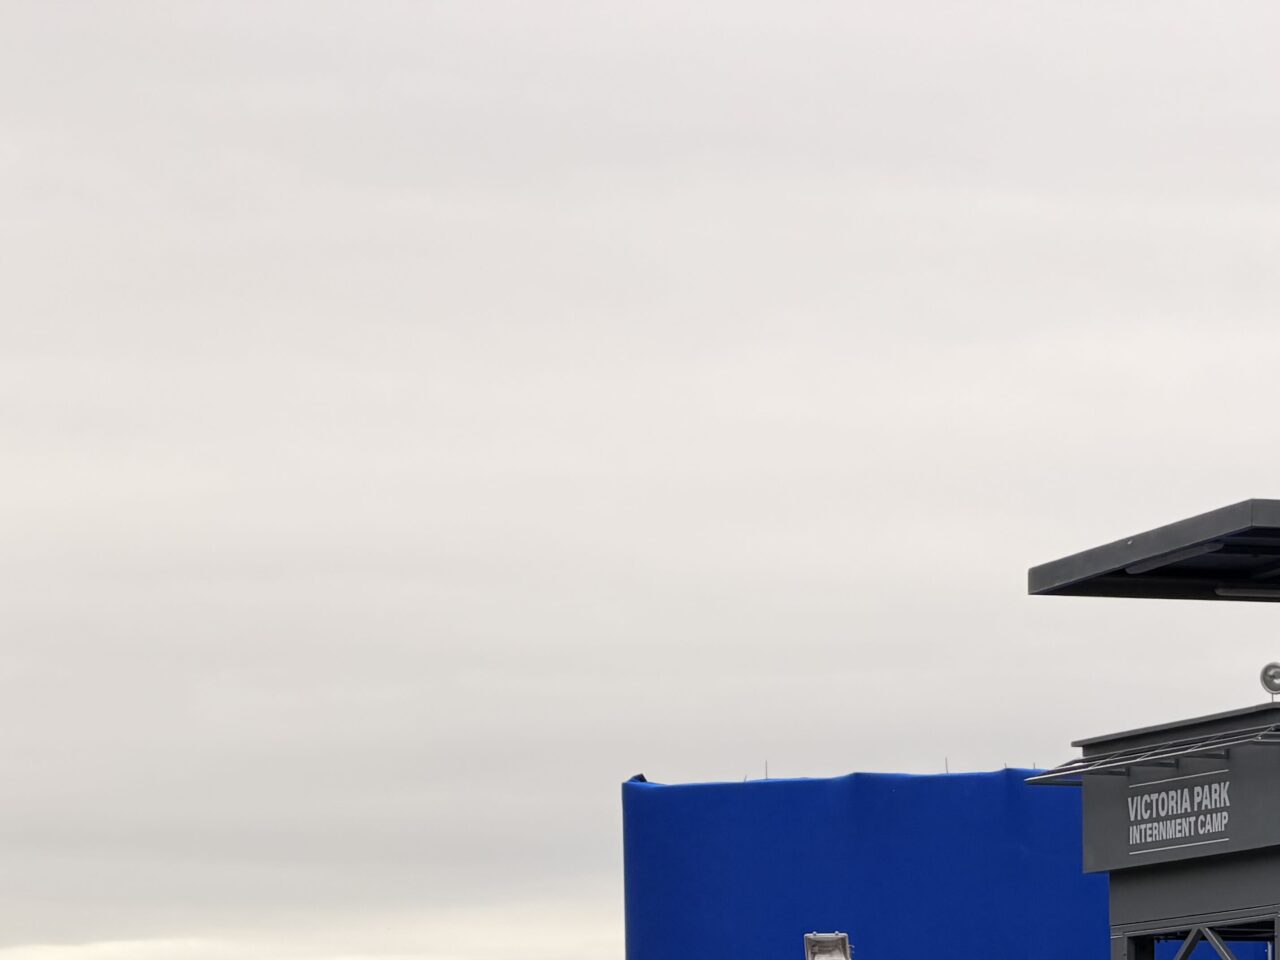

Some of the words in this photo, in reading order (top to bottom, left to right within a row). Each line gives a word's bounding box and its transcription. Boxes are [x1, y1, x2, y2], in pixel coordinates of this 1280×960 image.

[1128, 788, 1191, 821] VICTORIA
[1194, 781, 1230, 811] PARK
[1129, 816, 1196, 845] INTERNMENT
[1197, 811, 1229, 834] CAMP
